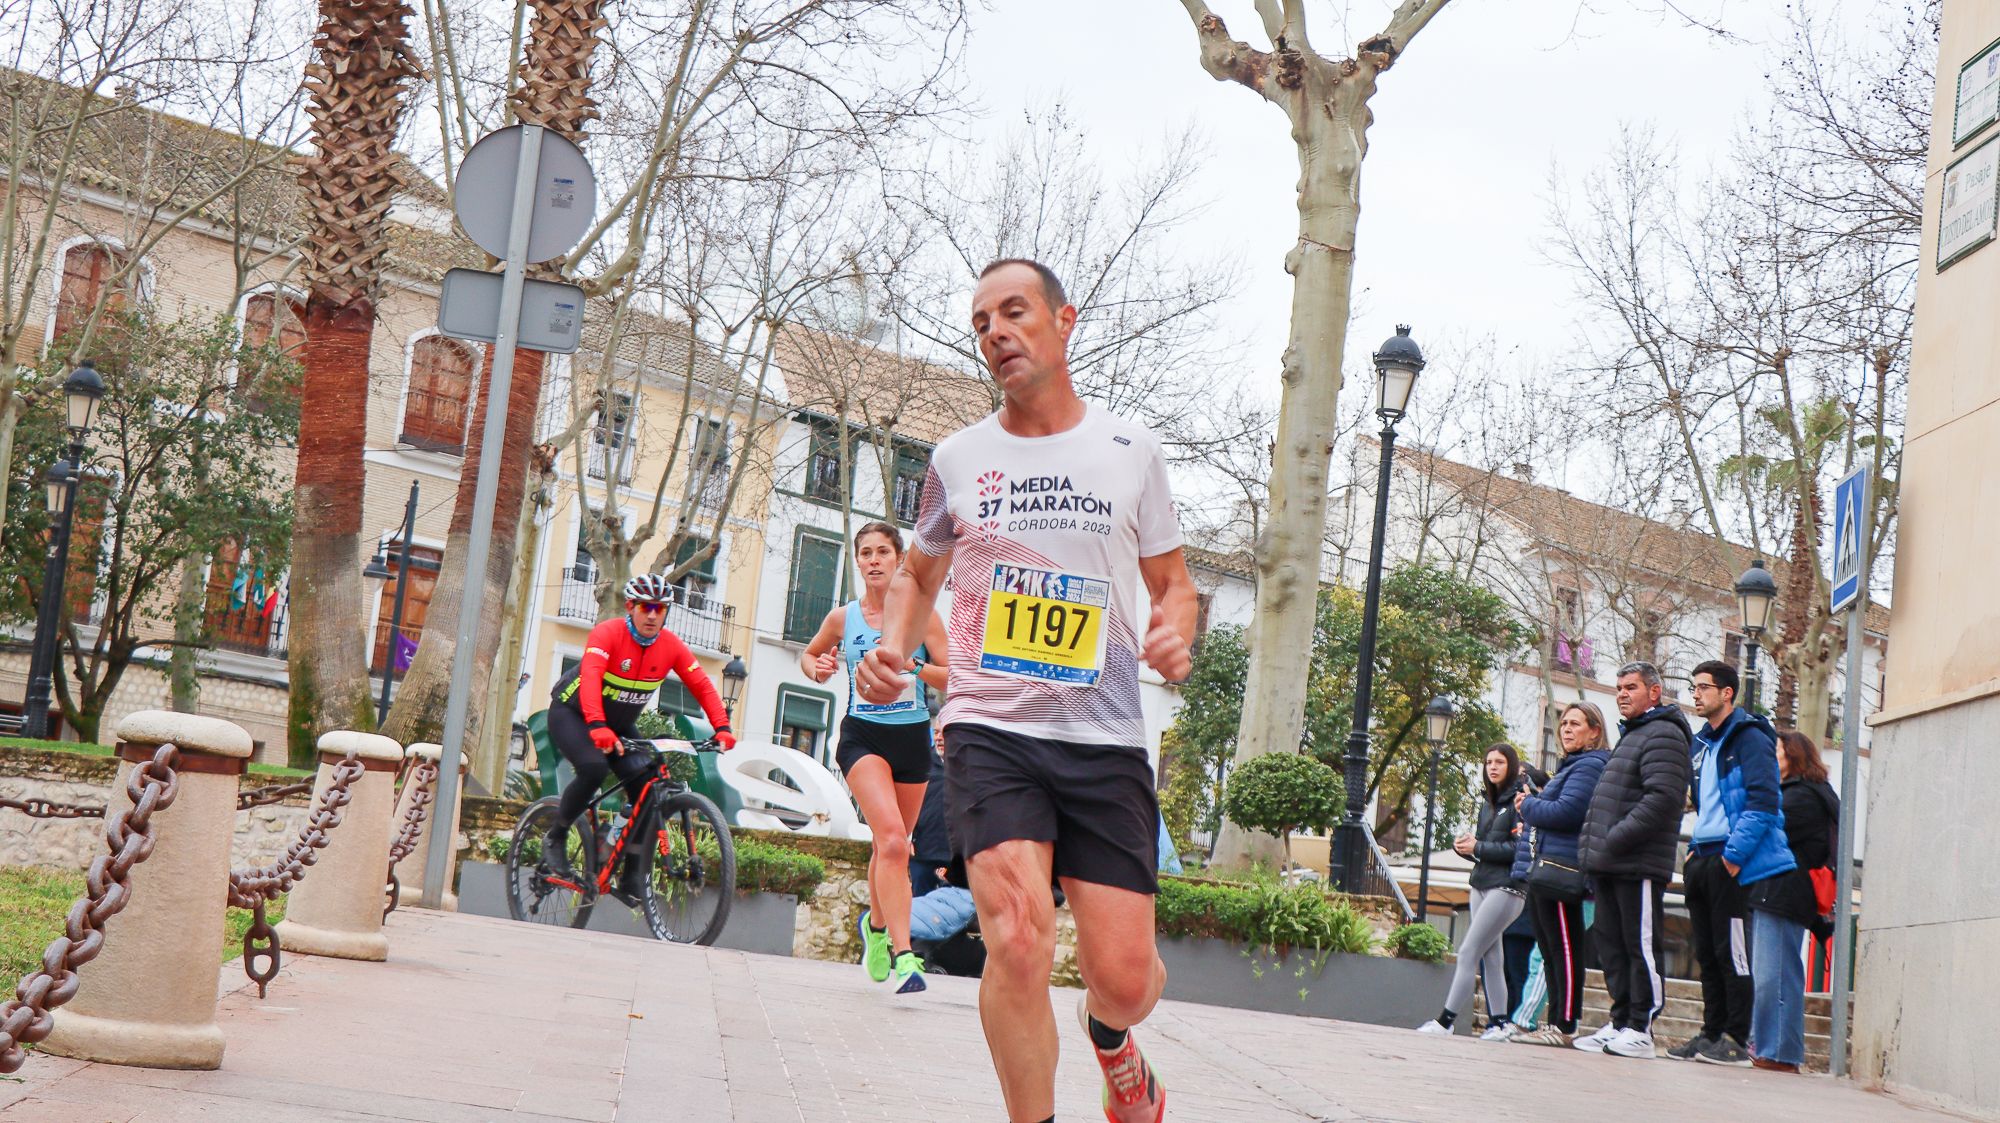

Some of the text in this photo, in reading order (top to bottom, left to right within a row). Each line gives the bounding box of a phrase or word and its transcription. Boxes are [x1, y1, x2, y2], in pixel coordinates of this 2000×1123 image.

[1965, 161, 1992, 193] Pasaje
[1010, 476, 1074, 495] MEDIA
[978, 492, 1112, 519] 37 MARATÓN
[1008, 518, 1111, 536] CÓRDOBA 2023
[1004, 598, 1091, 651] 1197
